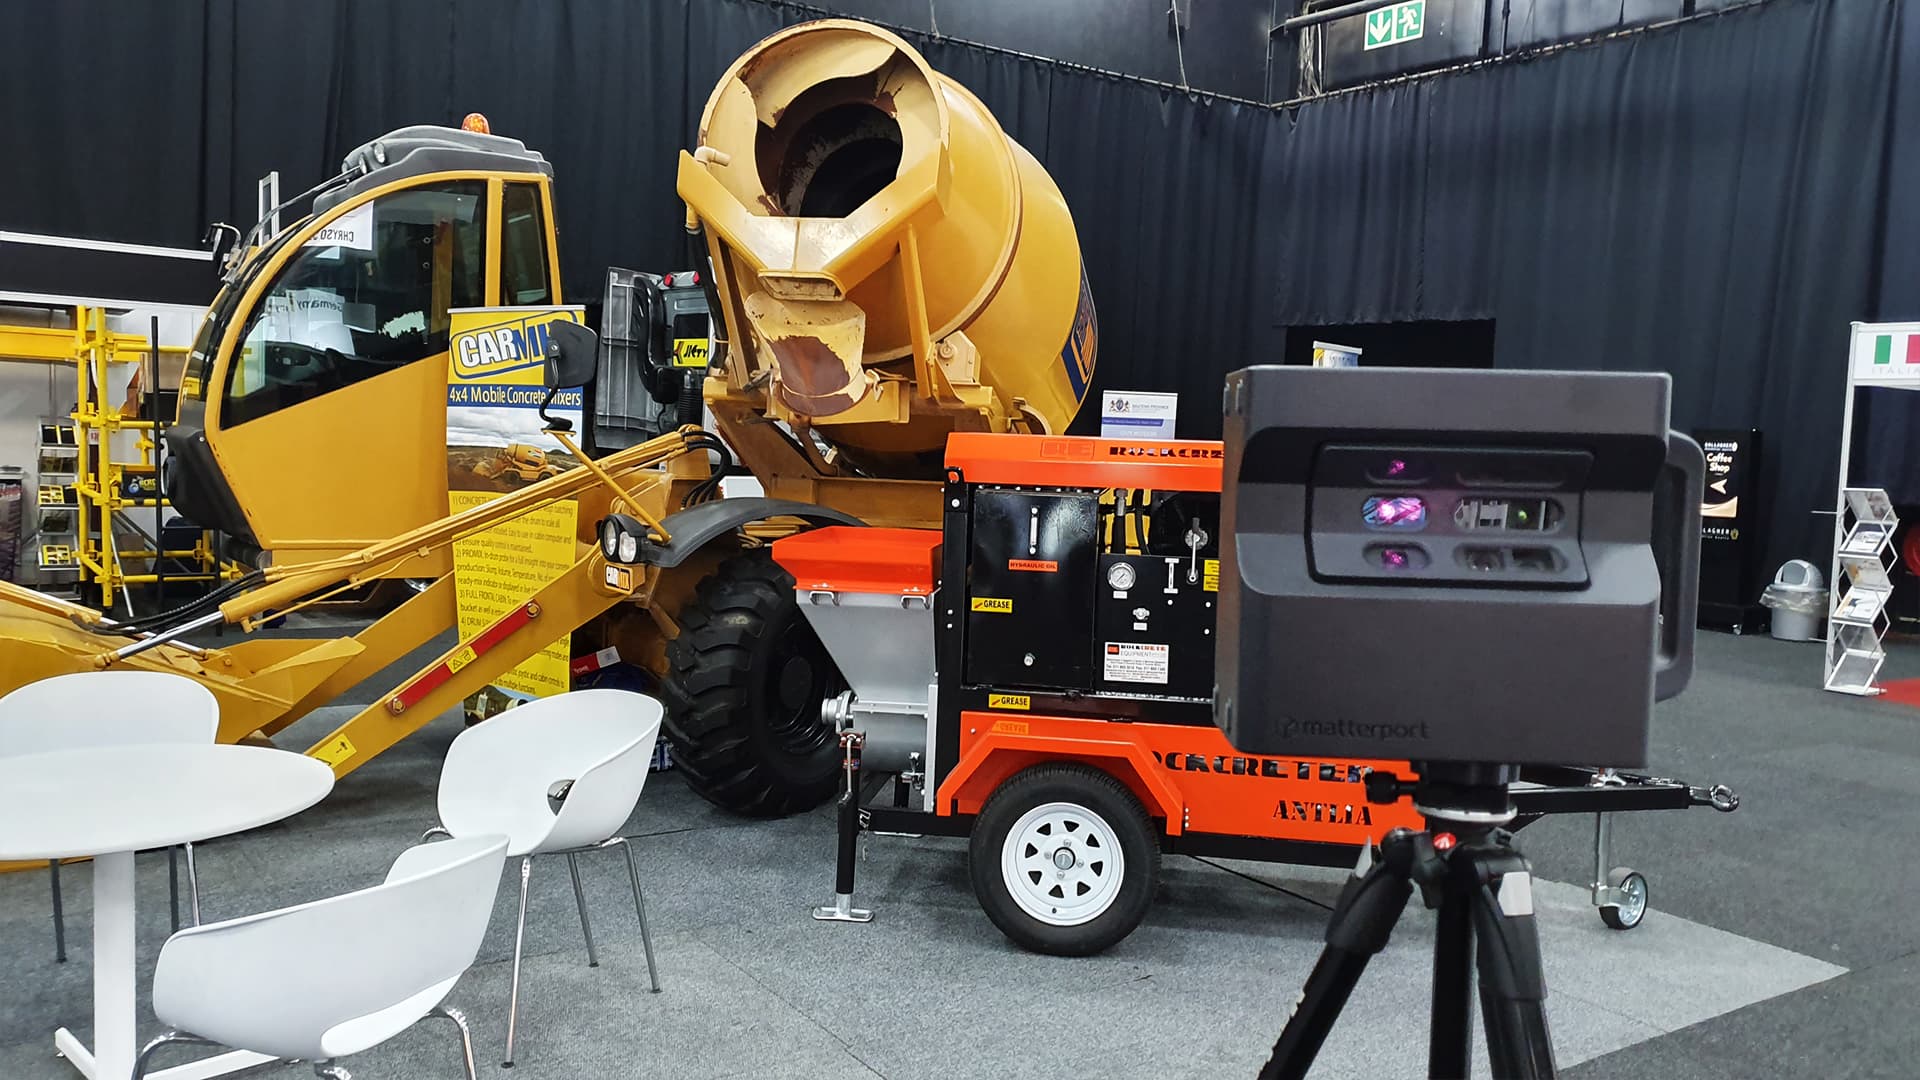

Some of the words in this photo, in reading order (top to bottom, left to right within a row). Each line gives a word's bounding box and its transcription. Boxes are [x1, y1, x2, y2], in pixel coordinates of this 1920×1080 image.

[459, 322, 550, 368] CARMI
[449, 387, 468, 402] 4x4
[471, 386, 506, 403] Mobile
[507, 386, 546, 405] Concrete
[1109, 446, 1224, 459] ROCKCRE
[1706, 452, 1733, 463] Coffee
[1709, 462, 1730, 474] Shop
[983, 600, 1010, 609] GREASE
[1001, 696, 1028, 706] GREASE
[1302, 718, 1431, 742] matterport
[1272, 800, 1373, 826] ANTLIA
